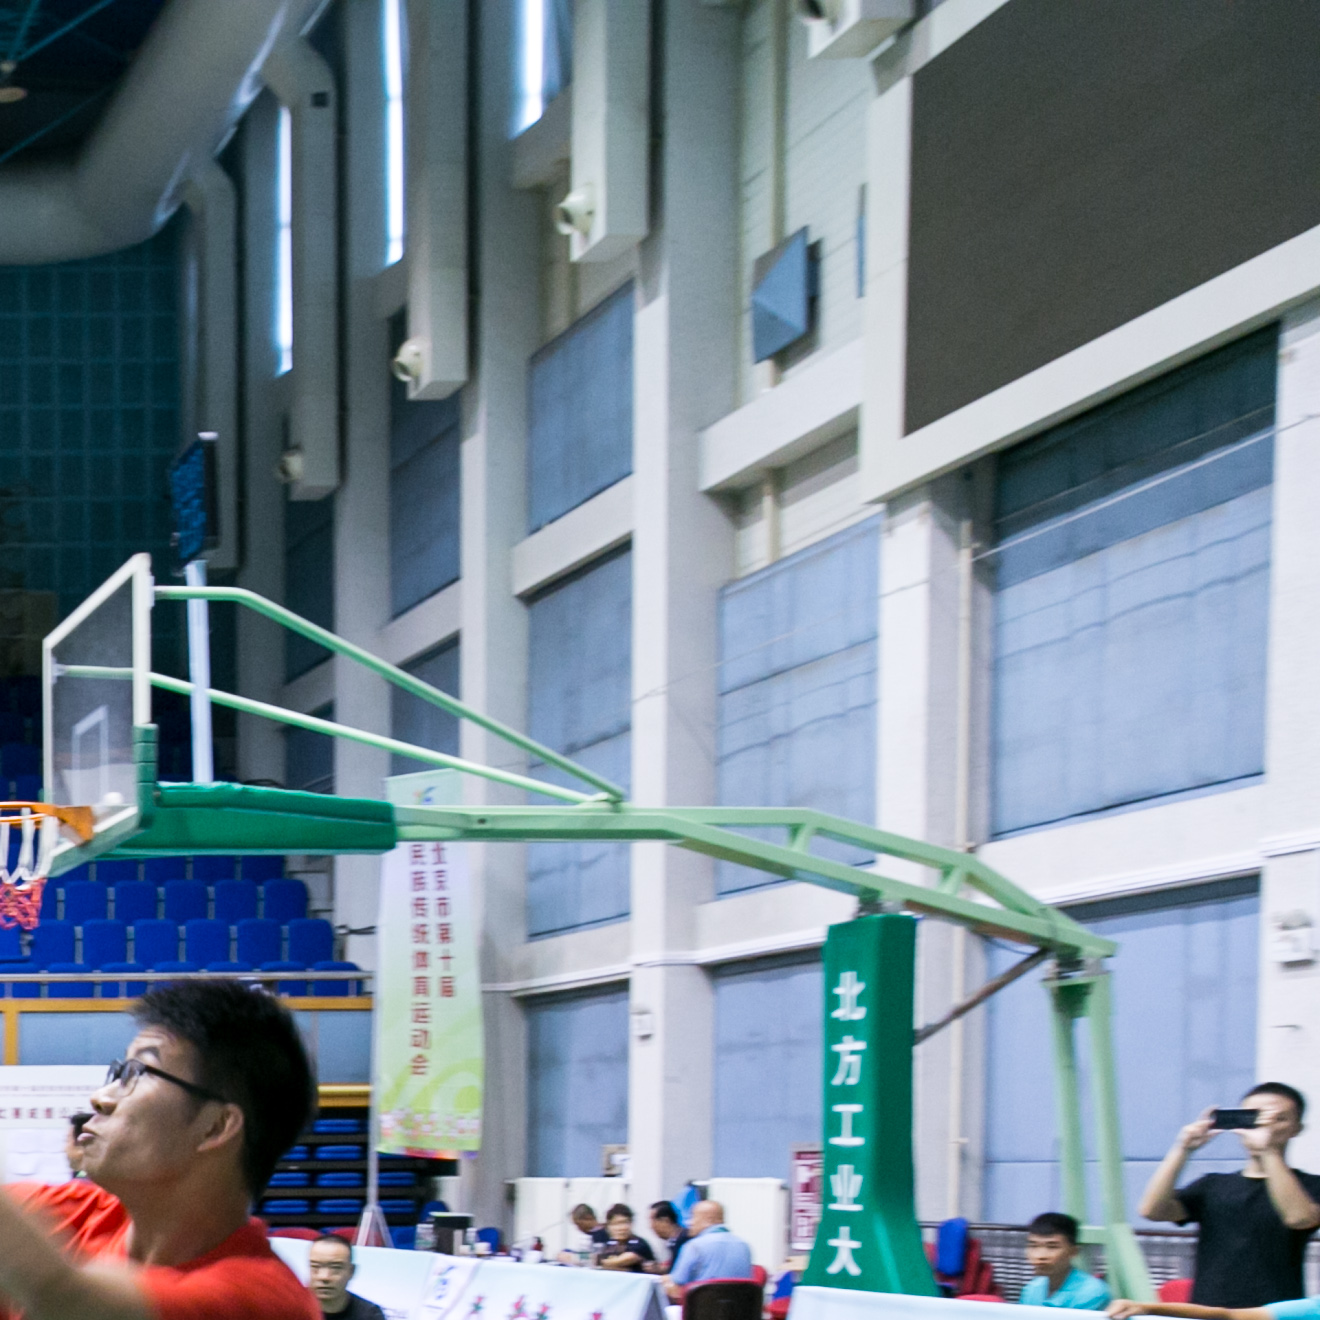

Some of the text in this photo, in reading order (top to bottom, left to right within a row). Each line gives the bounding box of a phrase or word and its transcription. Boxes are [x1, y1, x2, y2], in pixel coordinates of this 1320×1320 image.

[826, 971, 867, 1276] 北方工业大
